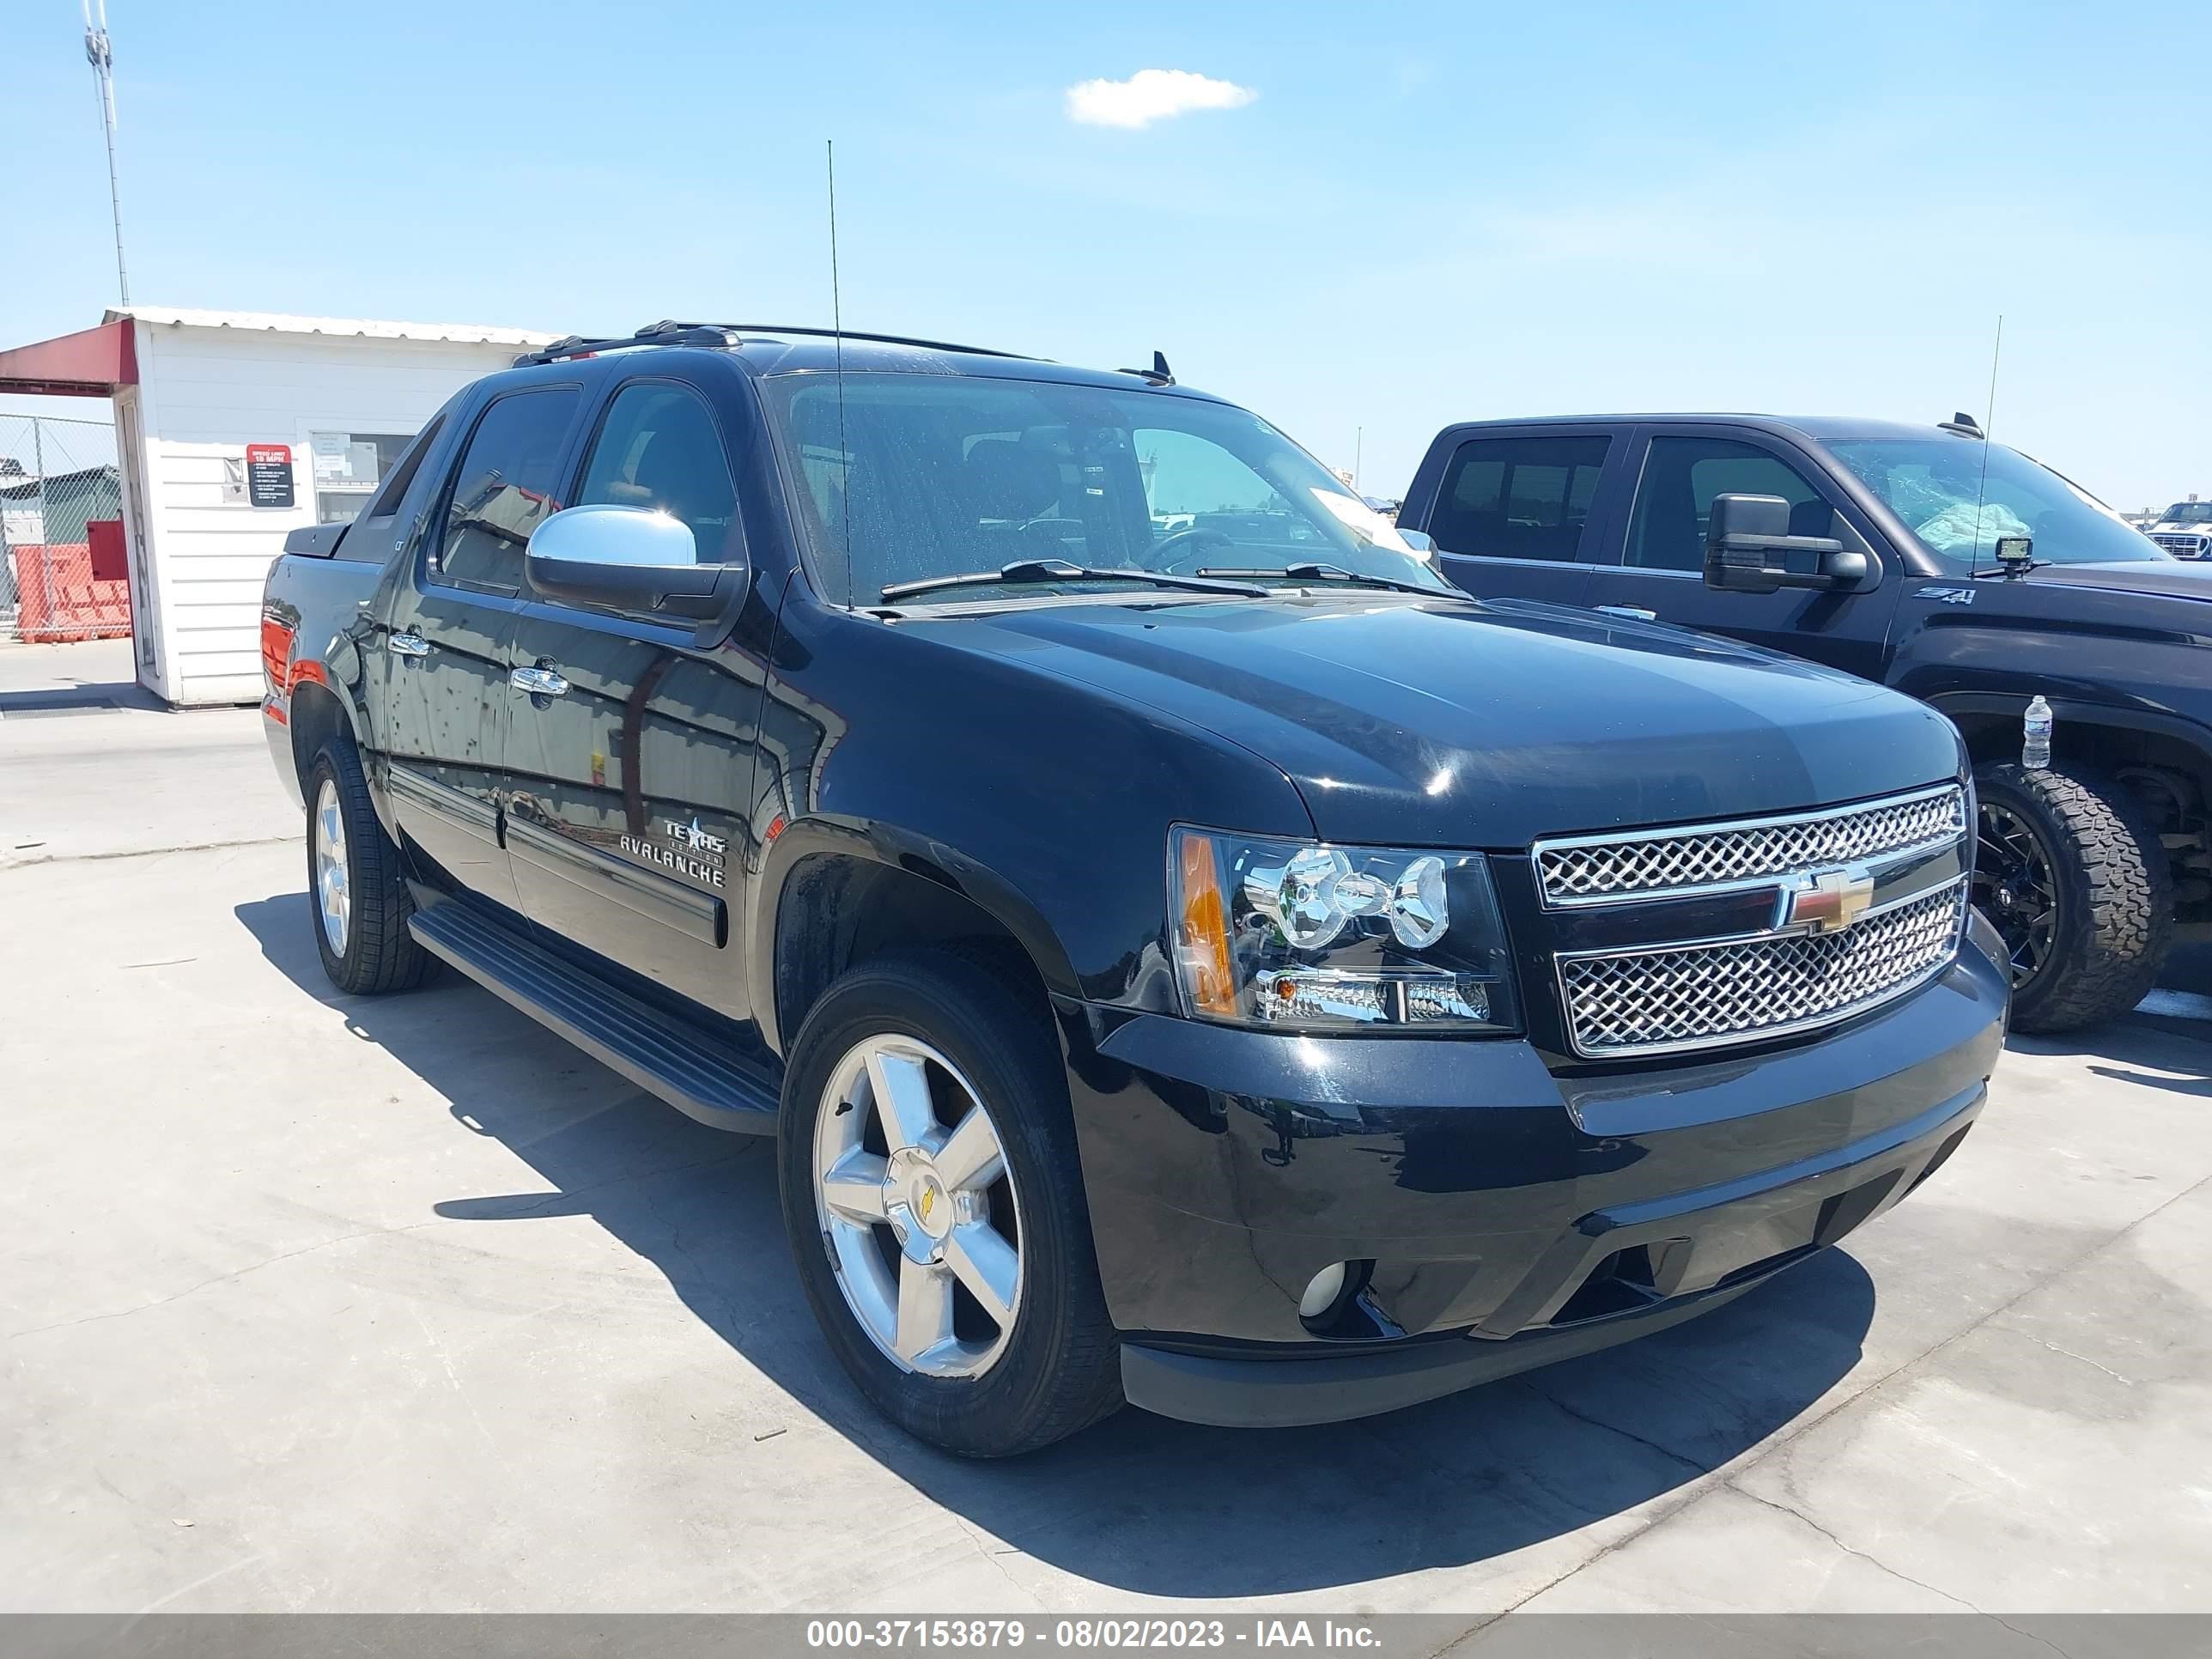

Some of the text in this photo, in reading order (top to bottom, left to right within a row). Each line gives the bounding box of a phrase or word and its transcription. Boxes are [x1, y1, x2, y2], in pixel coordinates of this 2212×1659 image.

[664, 817, 726, 853] TEXAS
[671, 841, 720, 865] EDITION
[620, 835, 726, 888] AVALANCHE
